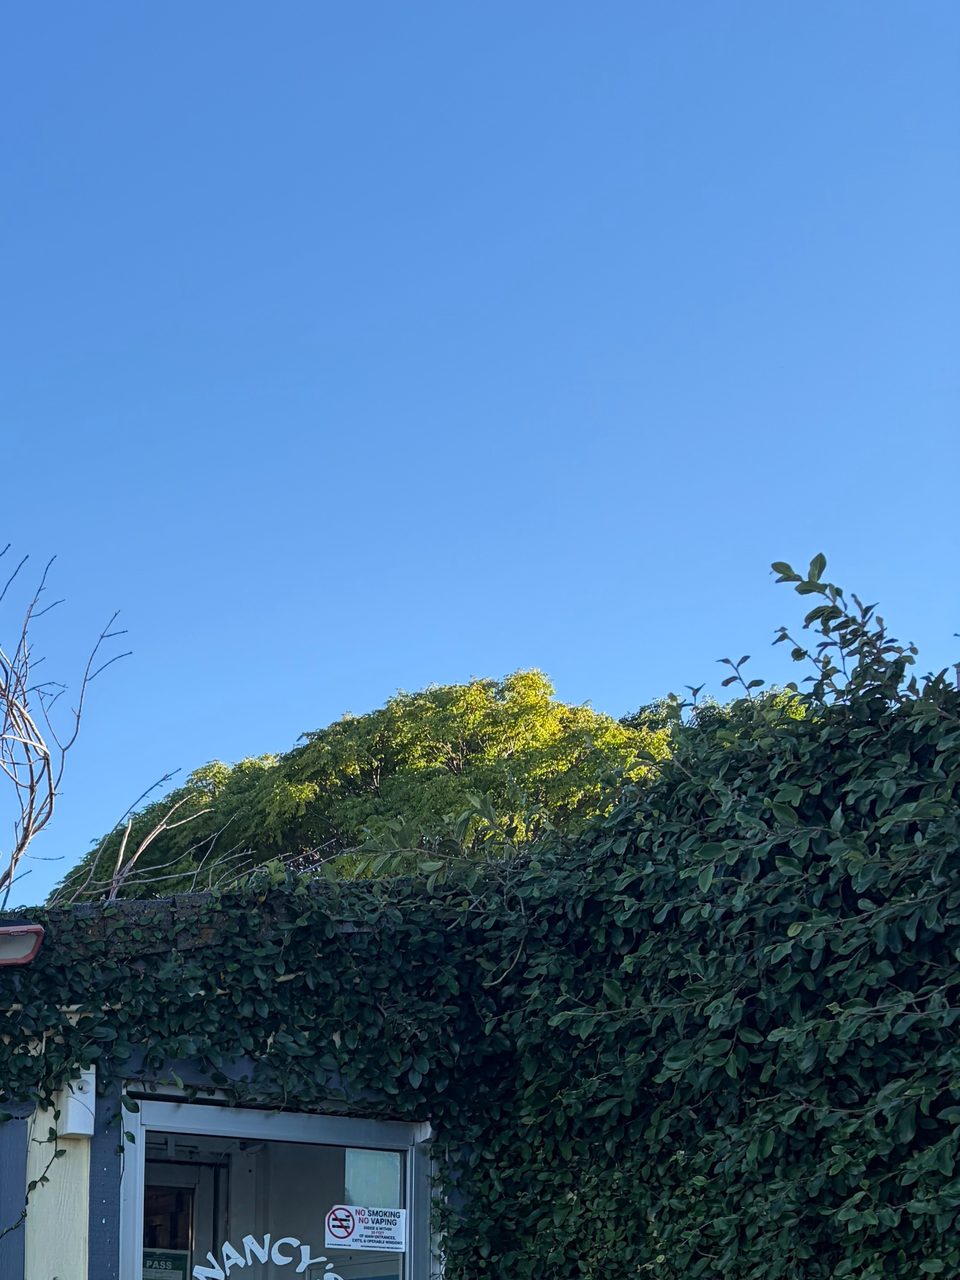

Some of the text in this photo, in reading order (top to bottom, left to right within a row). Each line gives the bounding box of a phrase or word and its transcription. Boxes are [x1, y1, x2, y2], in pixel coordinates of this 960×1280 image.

[355, 1209, 401, 1219] NO SMOKING
[370, 1218, 397, 1226] VAPING
[146, 1260, 172, 1270] PASS
